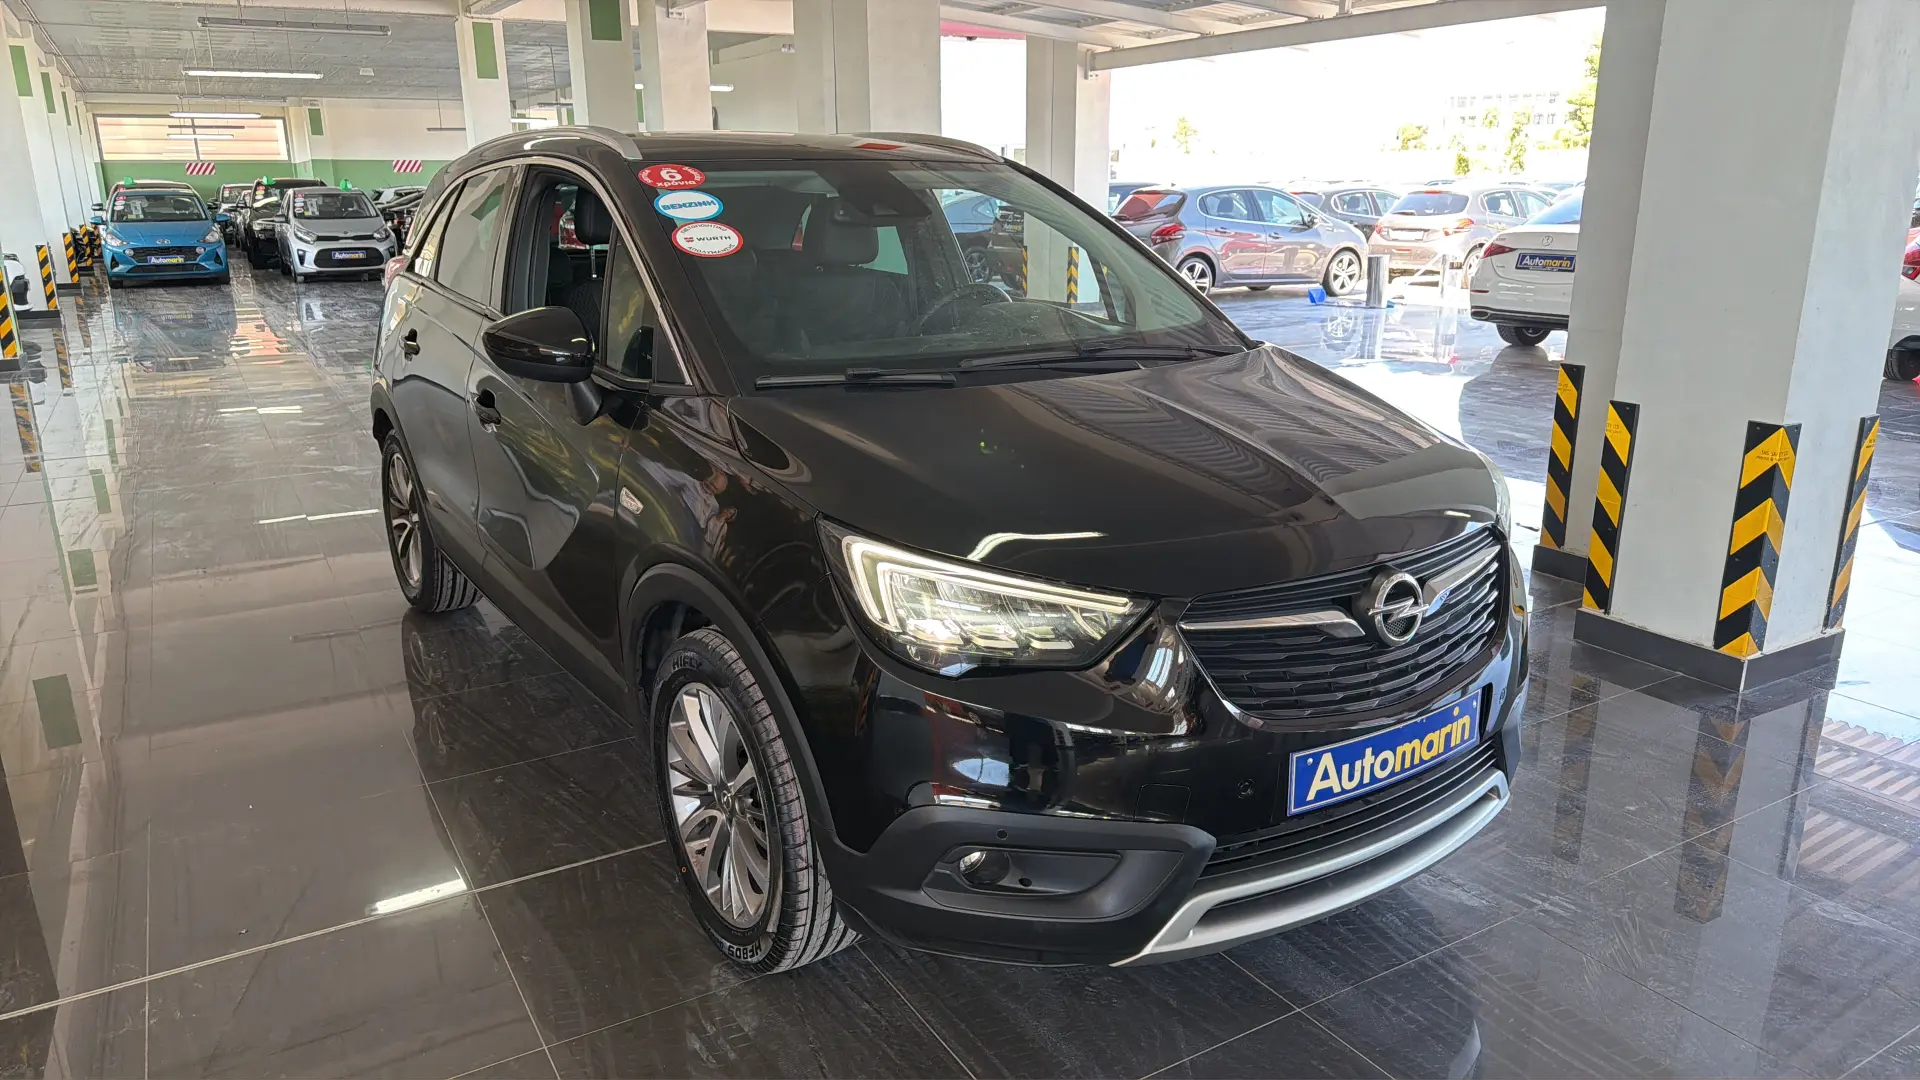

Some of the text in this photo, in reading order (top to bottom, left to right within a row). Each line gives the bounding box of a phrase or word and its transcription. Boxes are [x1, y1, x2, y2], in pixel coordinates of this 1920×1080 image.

[660, 169, 683, 181] 6
[657, 180, 697, 188] χρόνια
[151, 256, 184, 264] Automarin
[1522, 255, 1571, 267] Automarin
[1306, 706, 1471, 802] Automarin
